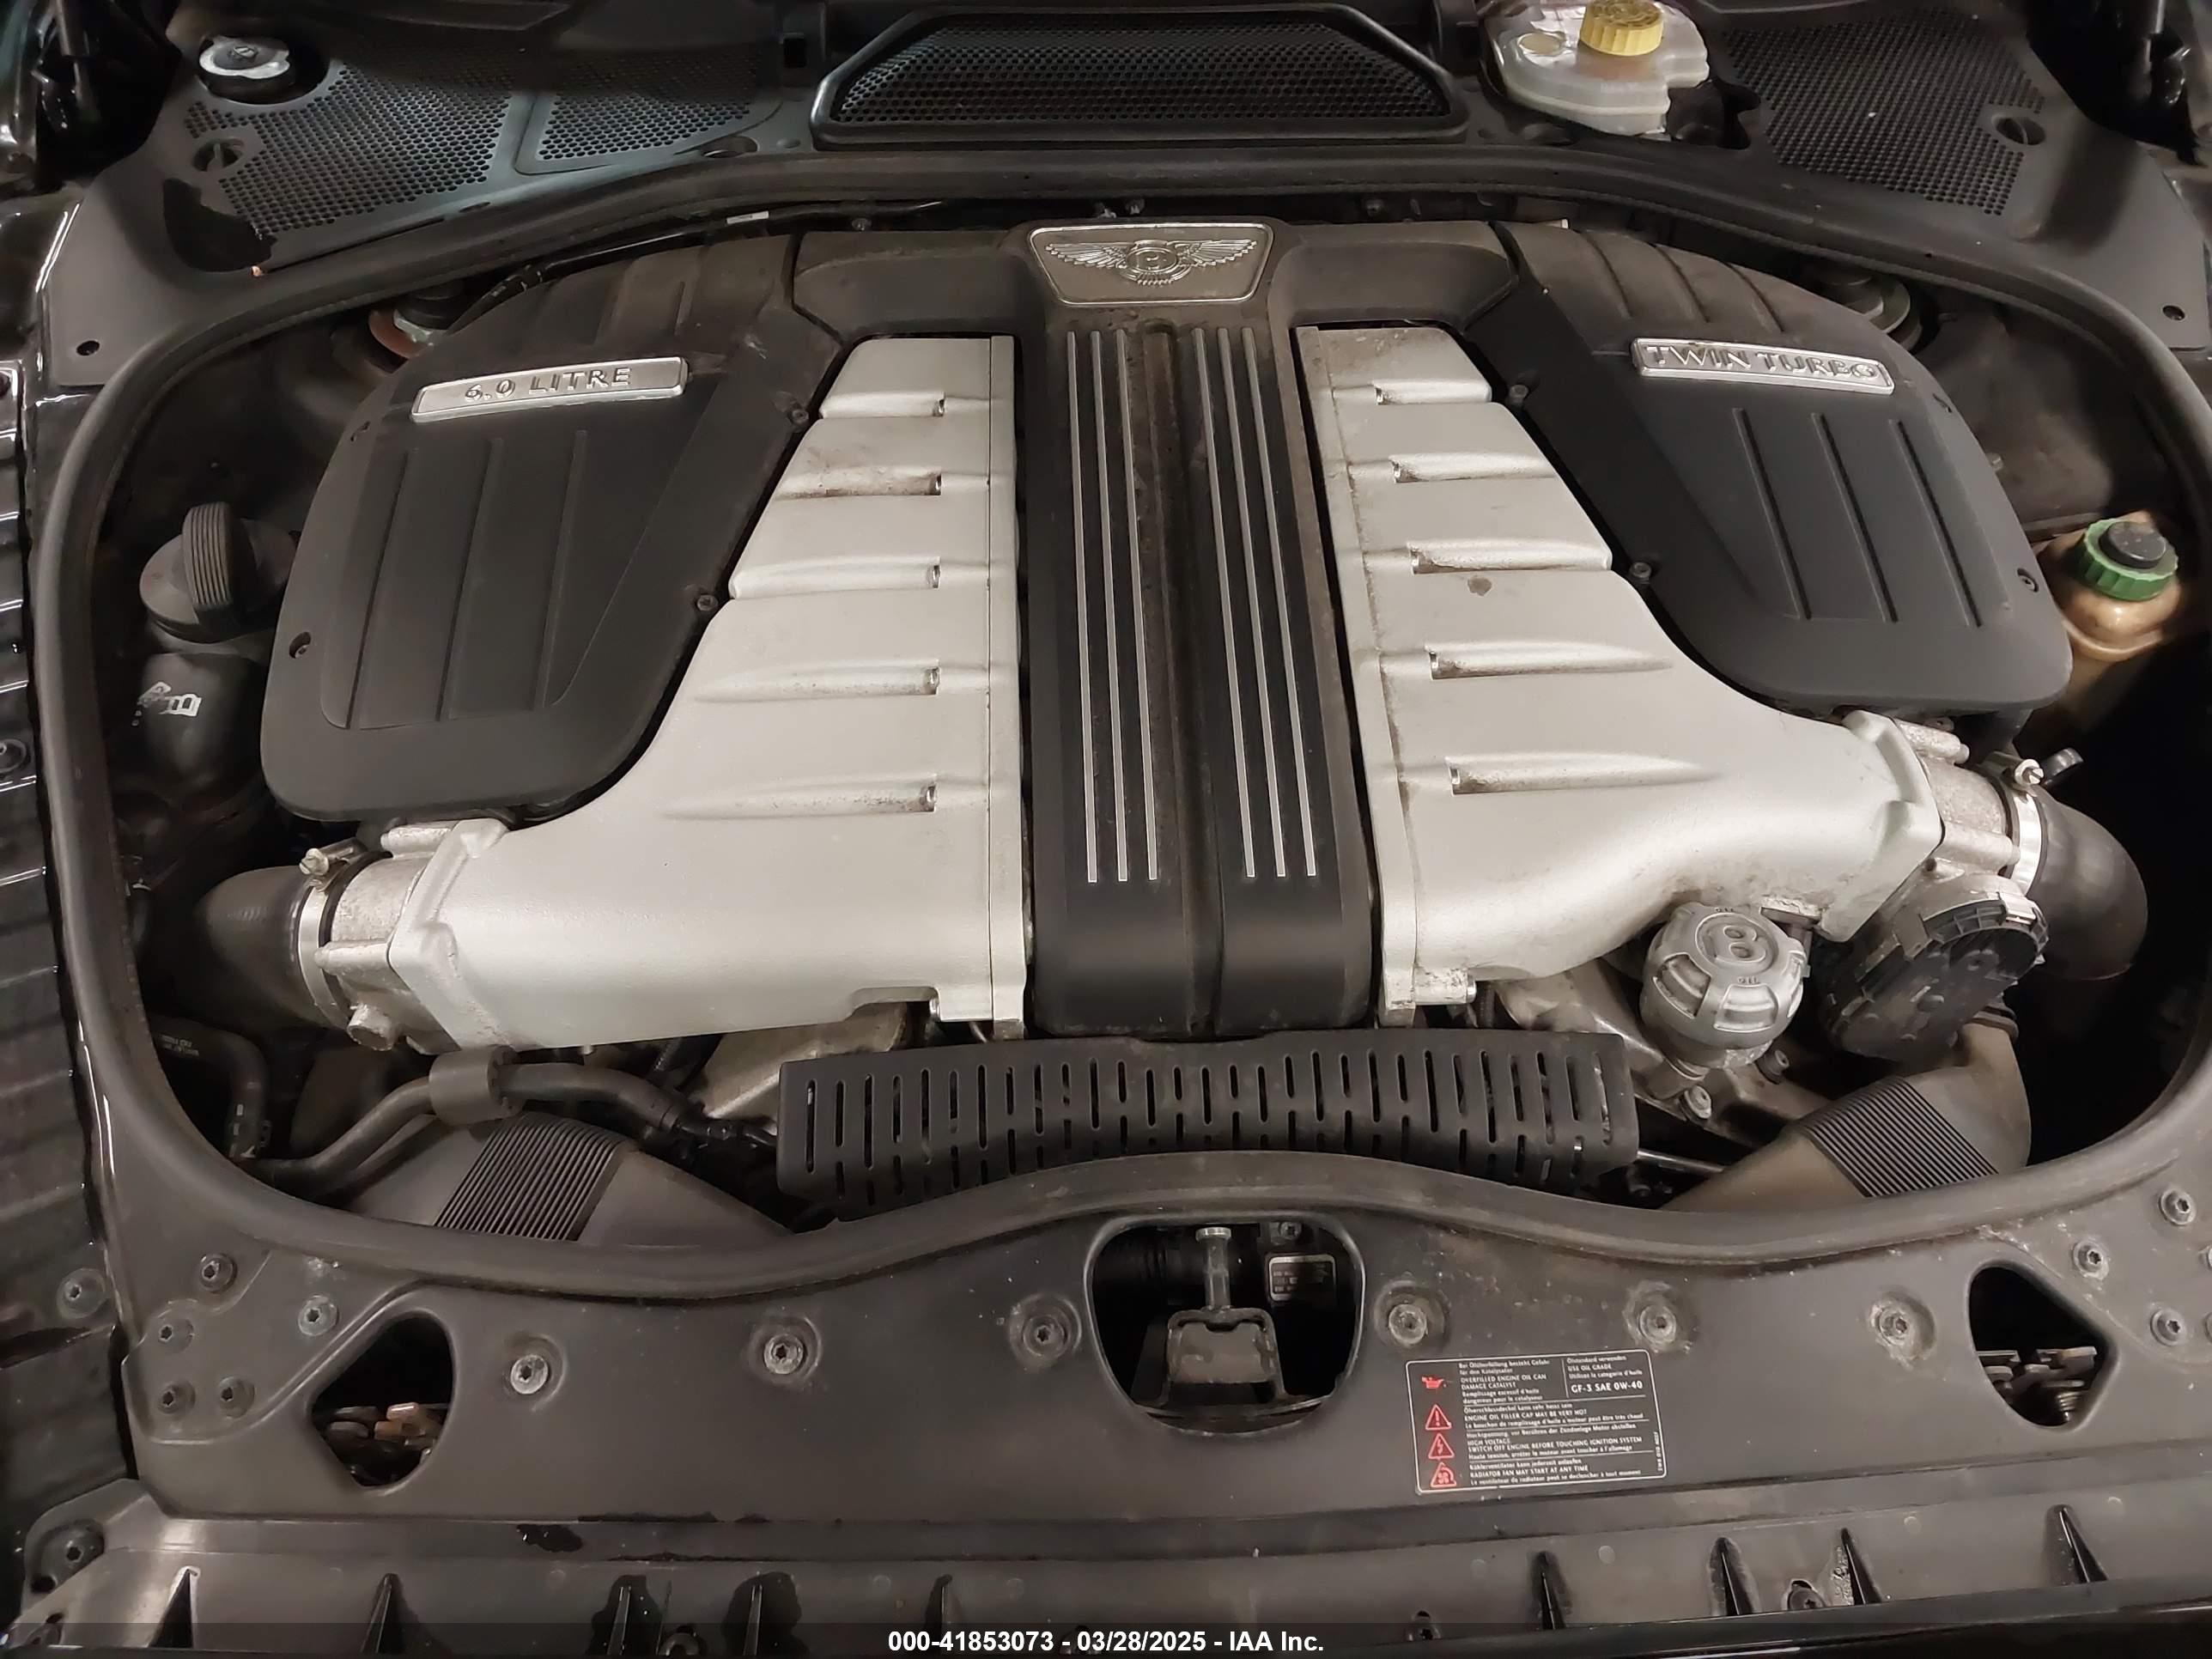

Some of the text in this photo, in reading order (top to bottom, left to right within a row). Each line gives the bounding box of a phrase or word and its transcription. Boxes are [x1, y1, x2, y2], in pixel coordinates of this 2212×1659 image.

[1646, 345, 1875, 379] TWIN TURBO
[465, 367, 631, 401] 6.0 LITRE
[1571, 1381, 1643, 1394] GF-3 SAE 0W-40
